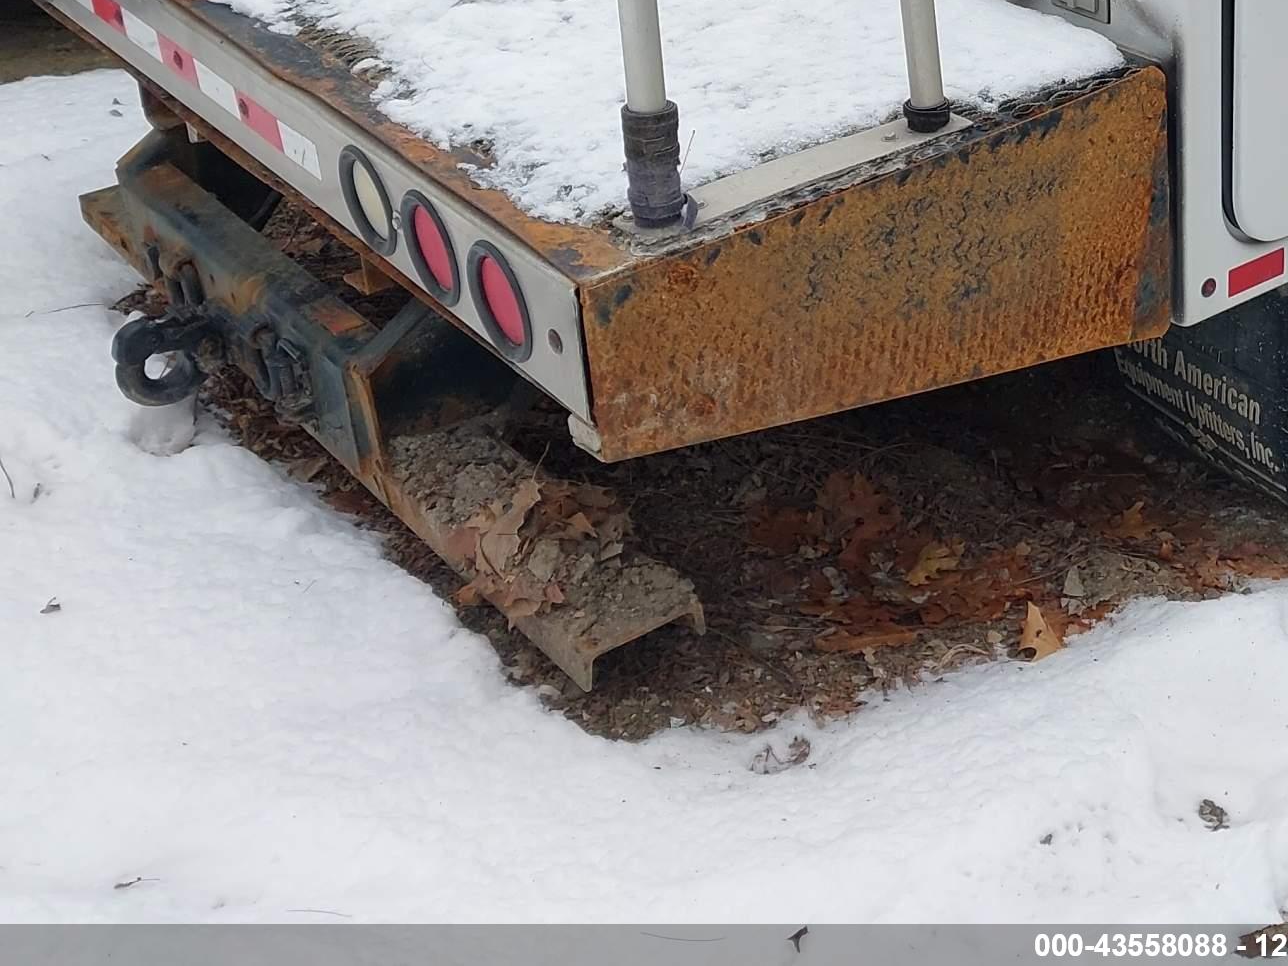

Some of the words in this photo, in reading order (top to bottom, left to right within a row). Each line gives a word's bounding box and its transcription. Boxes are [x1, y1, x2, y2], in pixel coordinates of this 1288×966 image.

[1114, 348, 1186, 412] Equipment
[1186, 392, 1250, 459] Upfitters,
[1250, 431, 1280, 472] Inc.
[1128, 338, 1168, 370] orth
[1174, 351, 1261, 424] American
